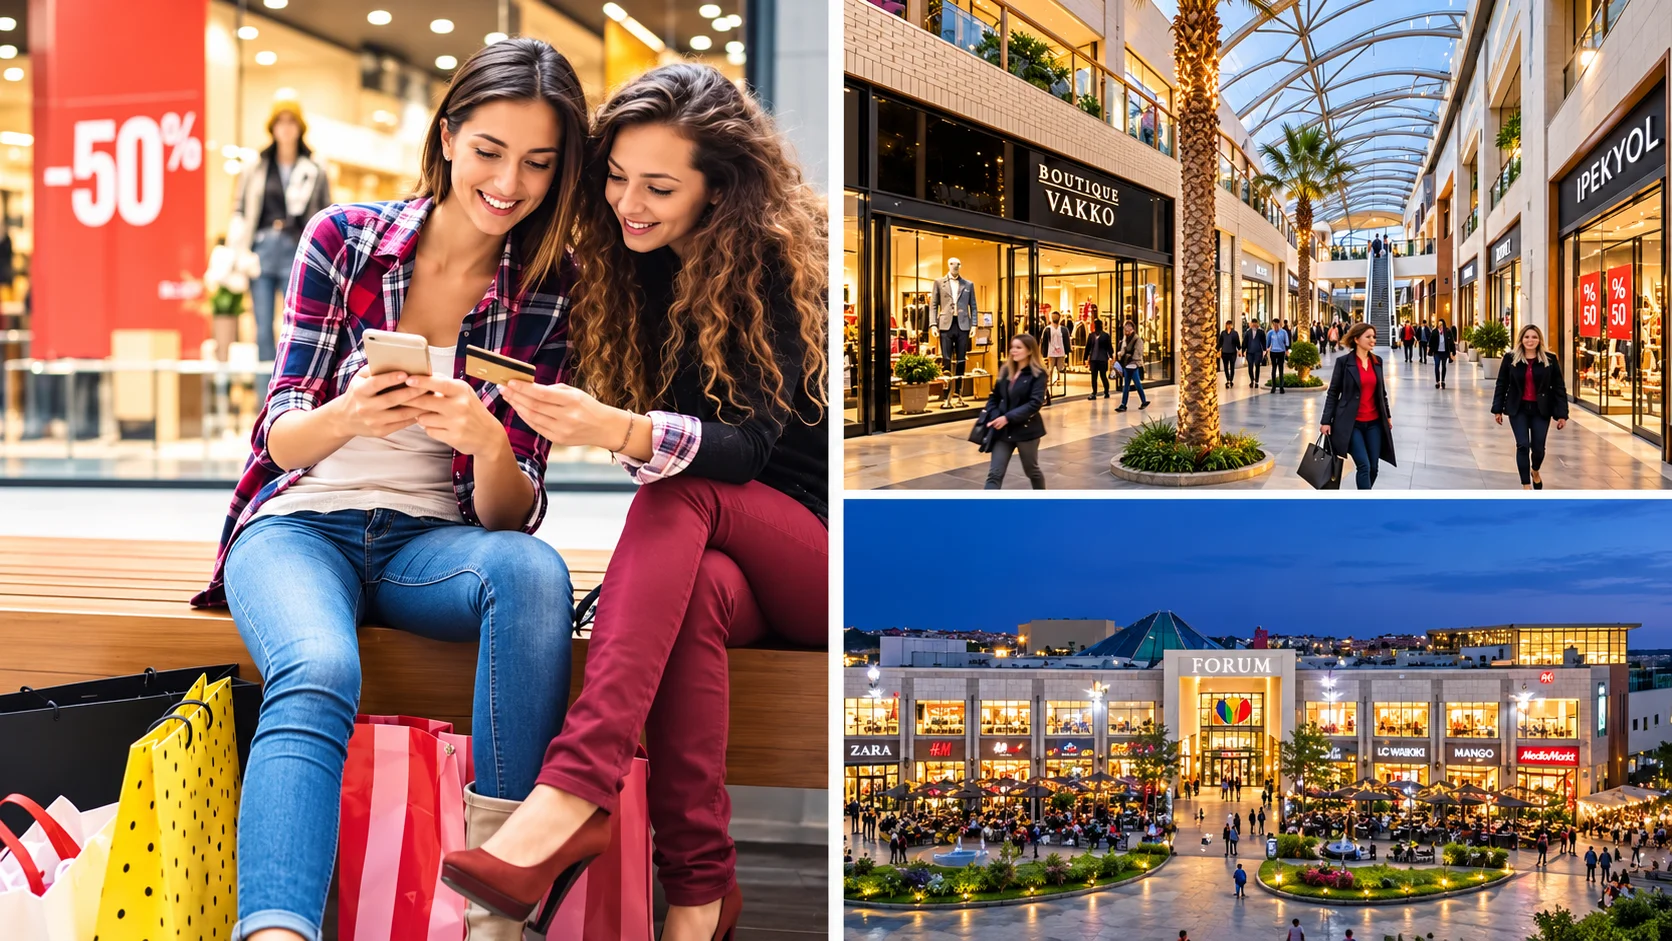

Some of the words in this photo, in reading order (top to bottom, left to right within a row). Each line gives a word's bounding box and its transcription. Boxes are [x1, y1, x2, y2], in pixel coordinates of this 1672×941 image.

[44, 110, 202, 227] -50%
[1577, 115, 1659, 204] IPEKYOL
[1038, 163, 1119, 203] BOUTIQUE
[1045, 189, 1115, 227] VAKKO
[1583, 282, 1596, 302] %
[1611, 276, 1626, 299] %
[1583, 304, 1597, 326] 50
[1611, 303, 1626, 326] 50
[1191, 657, 1271, 673] FORUM
[850, 744, 892, 756] ZARA
[1377, 747, 1390, 757] LC
[1454, 748, 1494, 758] MANGO
